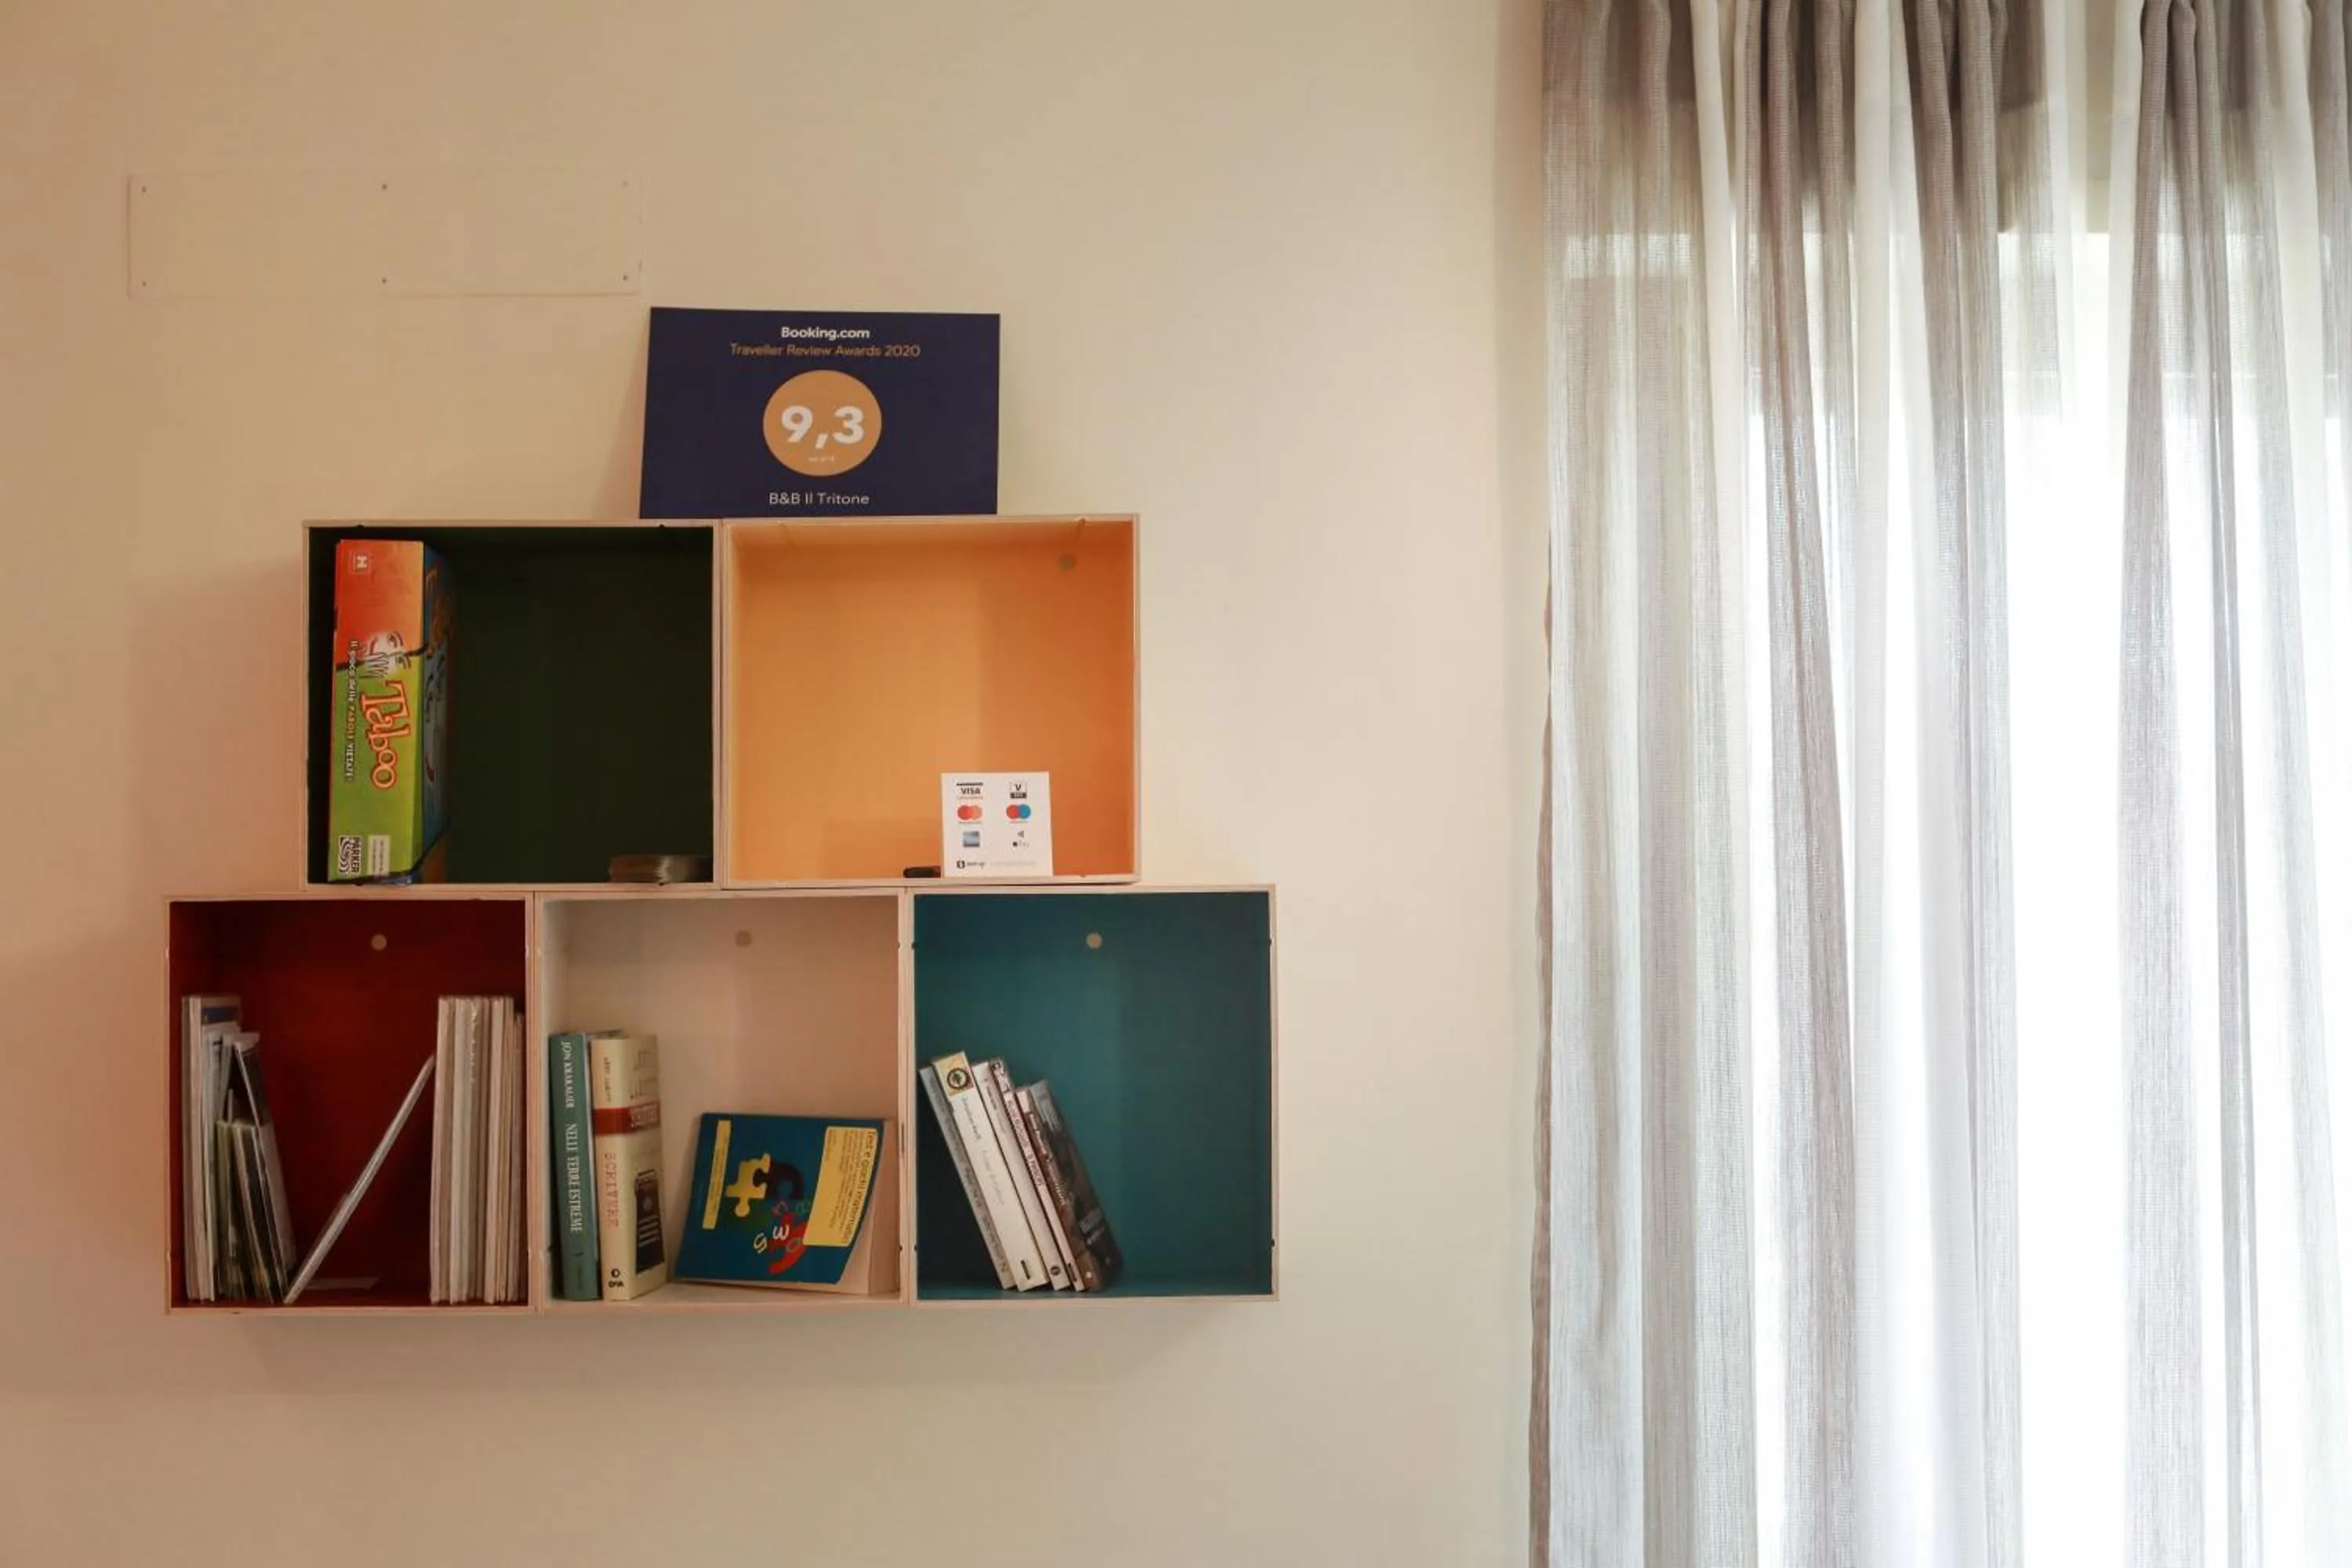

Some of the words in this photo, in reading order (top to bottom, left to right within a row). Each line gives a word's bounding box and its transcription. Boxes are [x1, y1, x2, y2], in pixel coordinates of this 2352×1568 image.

[730, 343, 782, 357] Traveller
[787, 344, 831, 356] Review
[835, 344, 882, 357] Awards
[884, 345, 921, 357] 2020
[781, 326, 870, 340] Booking.com
[780, 405, 865, 449] 9,3
[769, 492, 800, 505] B&B
[817, 492, 870, 505] Tritone
[360, 680, 412, 791] Taboo
[350, 836, 361, 873] PARKER
[561, 1040, 572, 1058] JON
[570, 1188, 583, 1232] ESTREME
